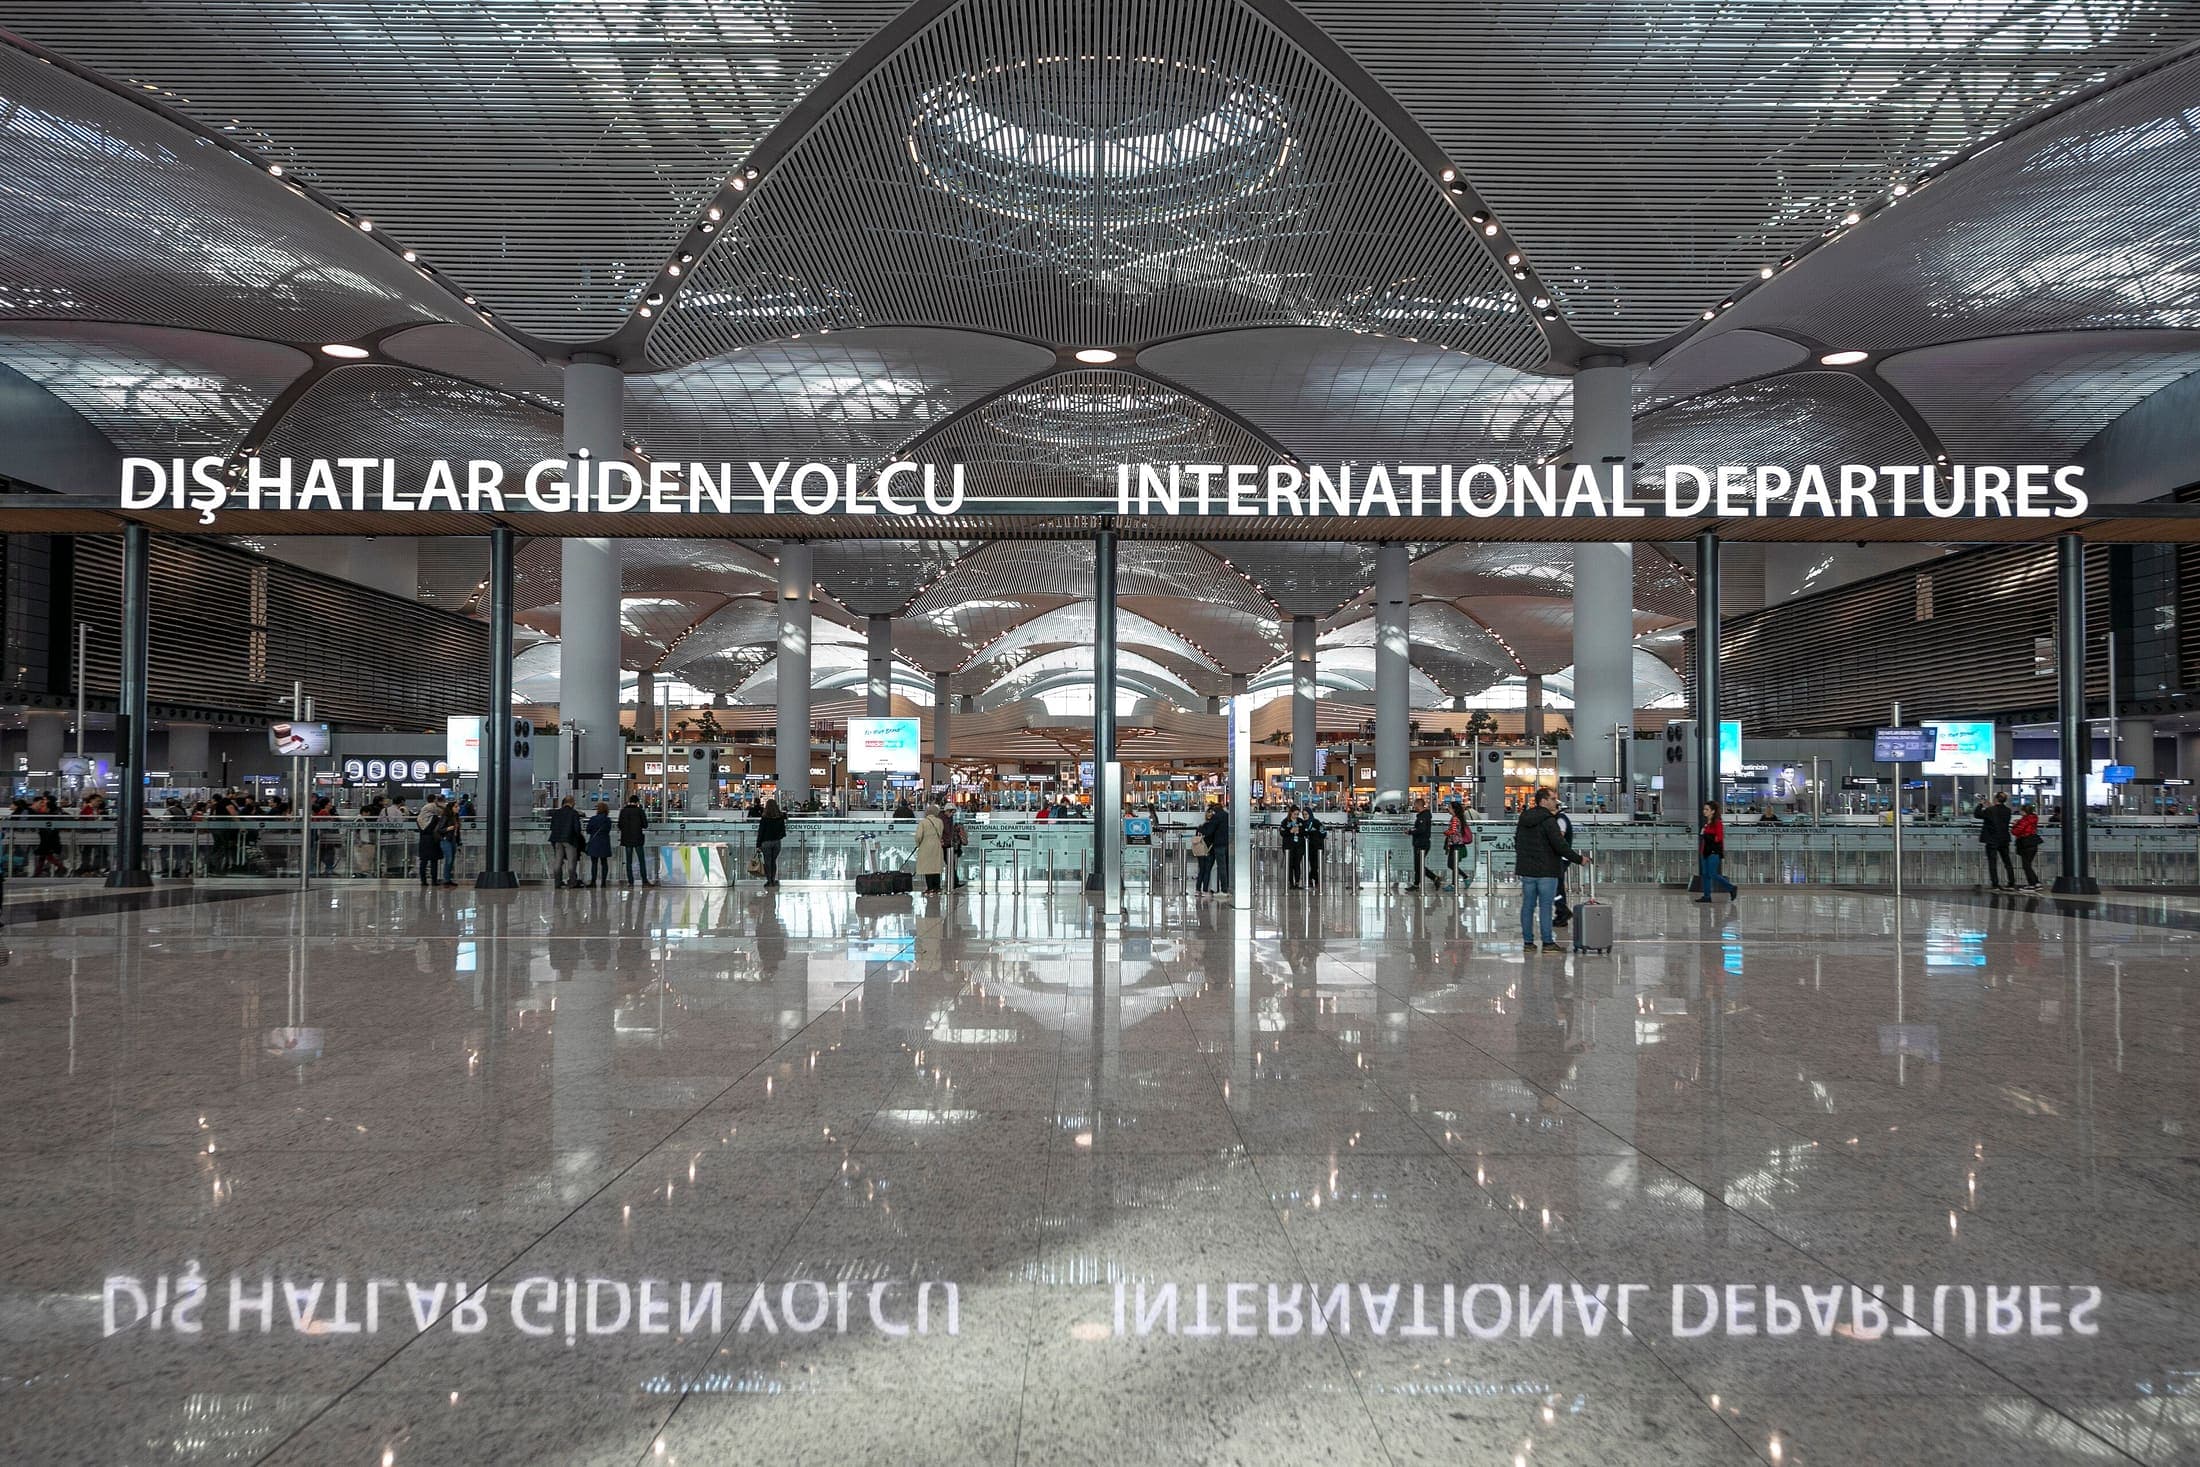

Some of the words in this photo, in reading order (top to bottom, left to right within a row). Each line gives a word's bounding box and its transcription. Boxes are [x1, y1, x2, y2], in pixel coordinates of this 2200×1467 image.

[122, 457, 227, 523] DIŞ
[248, 457, 506, 512] HATLAR
[524, 447, 731, 513] GİDEN
[747, 461, 967, 516] YOLCU
[1117, 463, 1646, 517] INTERNATIONAL
[1665, 464, 2089, 518] DEPARTURES
